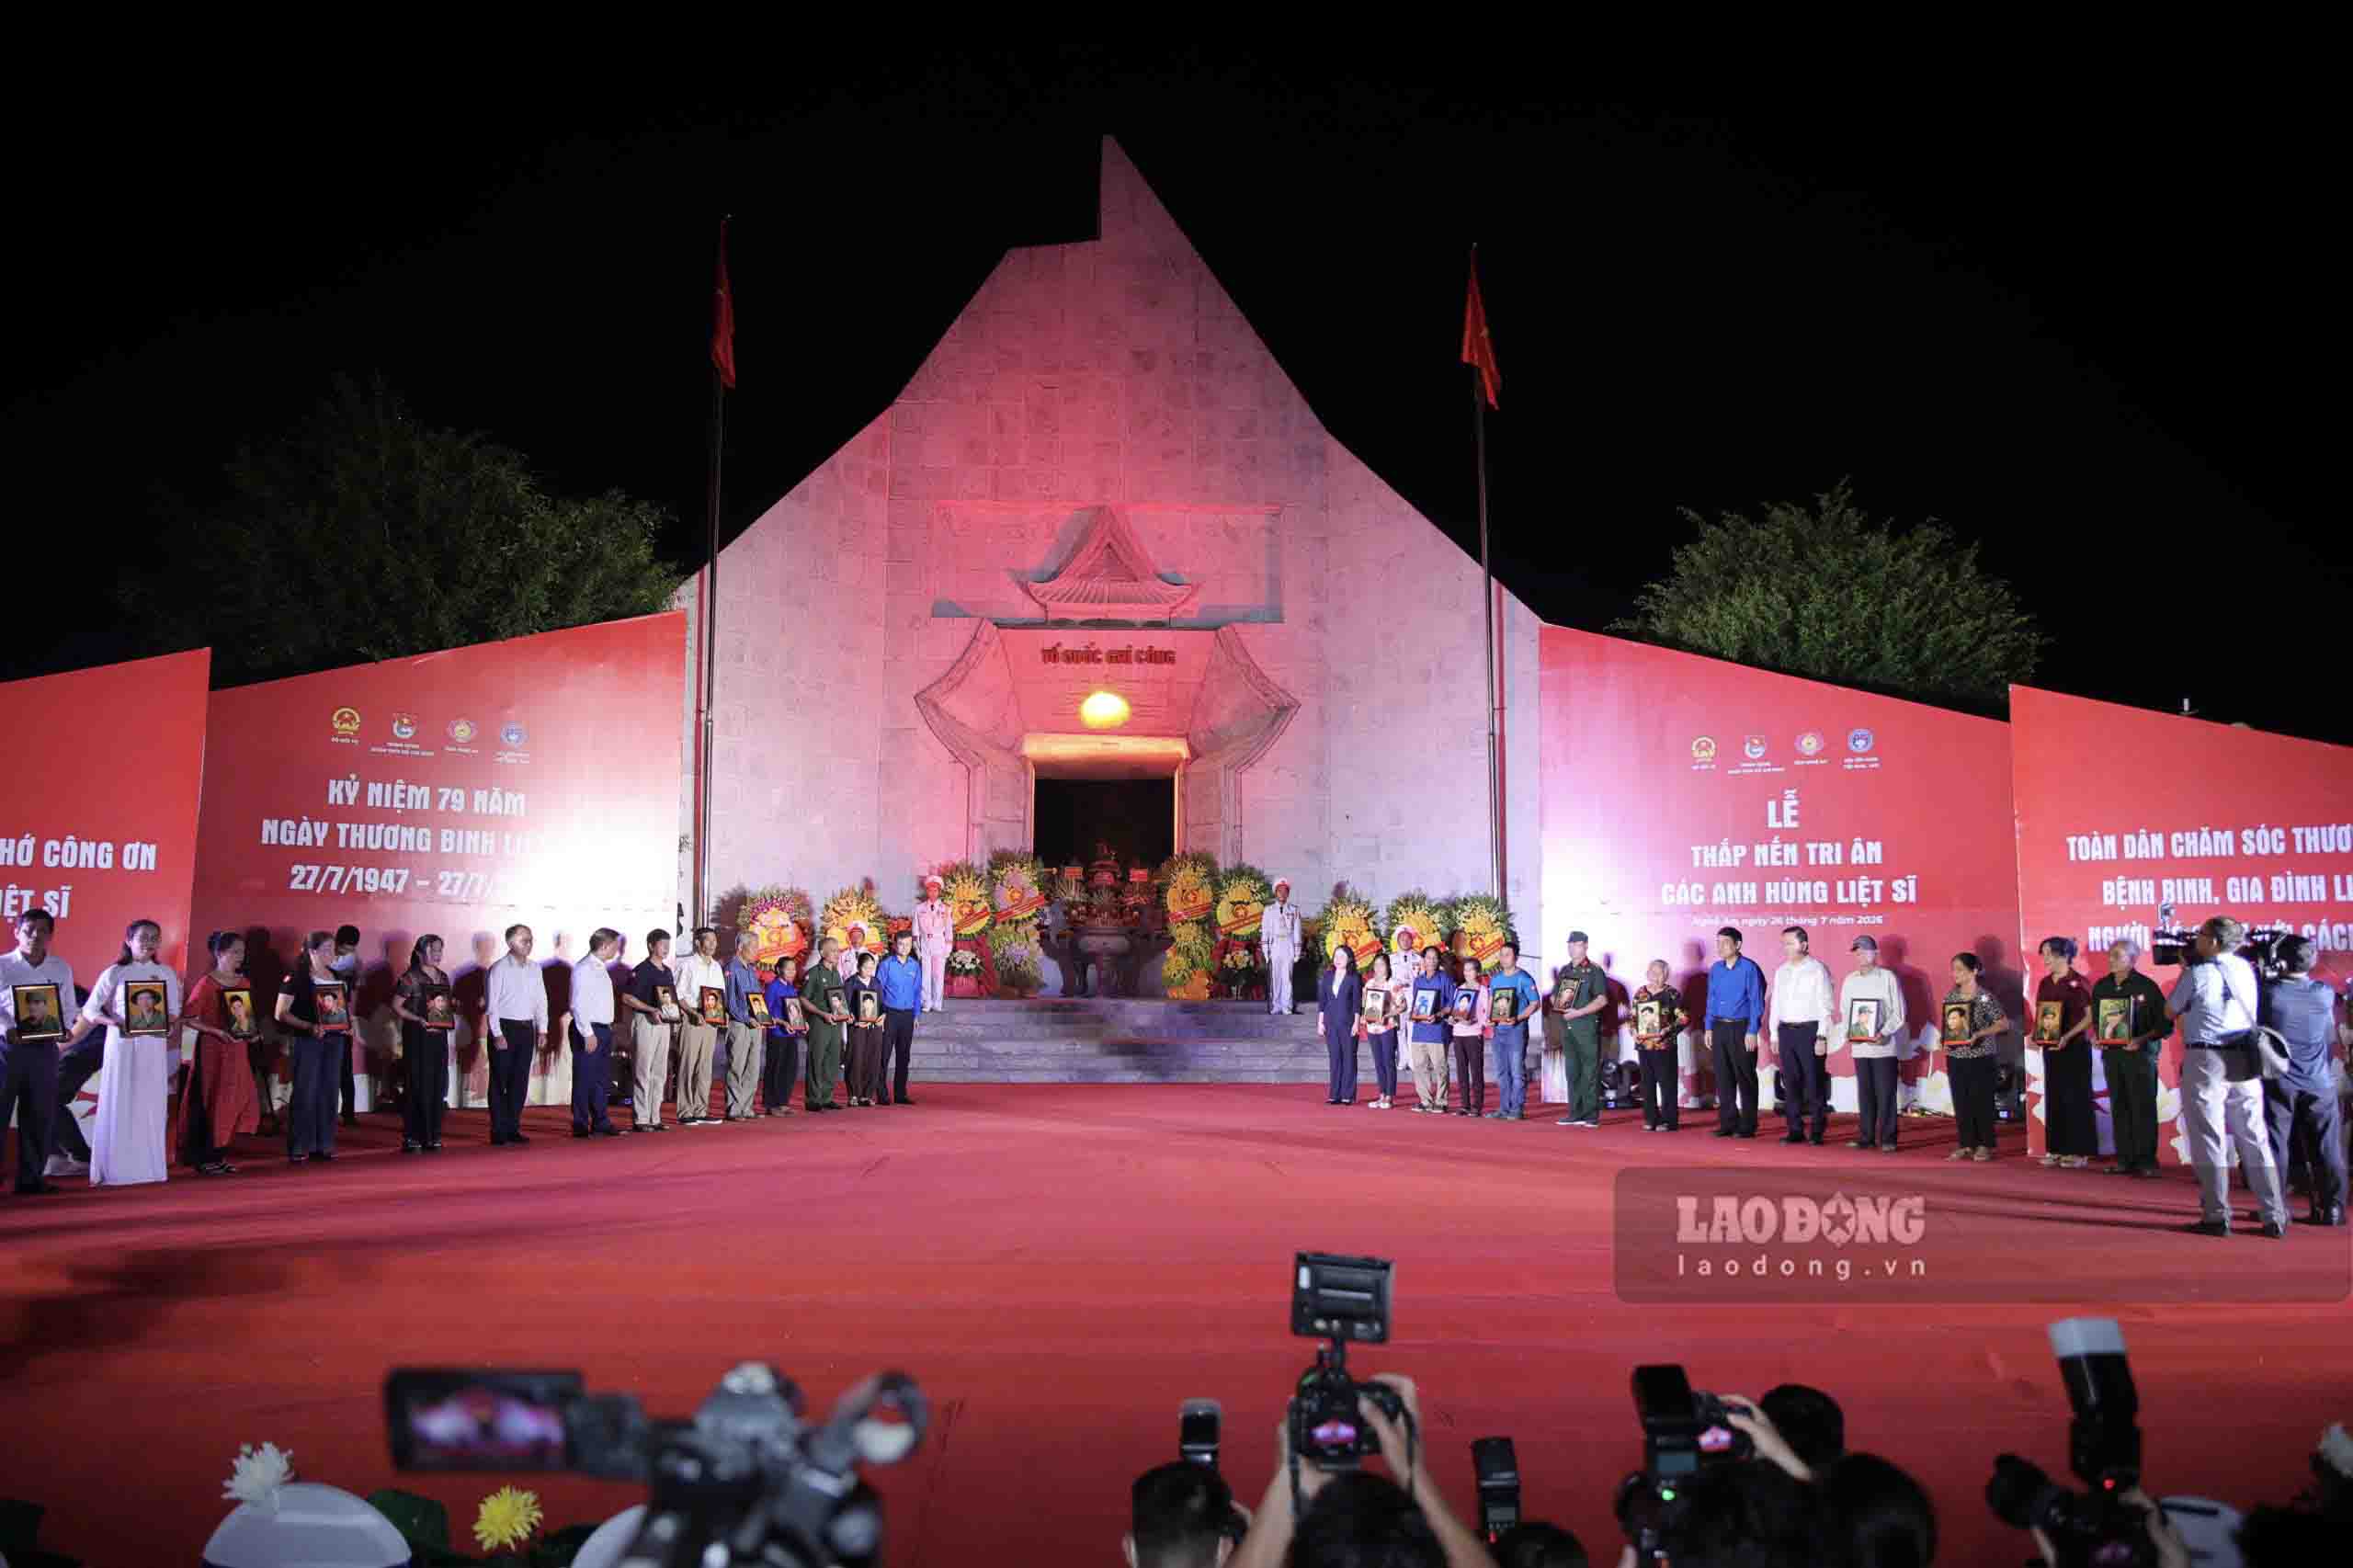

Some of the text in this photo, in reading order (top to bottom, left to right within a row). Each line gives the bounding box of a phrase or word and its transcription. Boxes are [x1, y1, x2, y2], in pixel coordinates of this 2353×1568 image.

[327, 773, 527, 816] KỶ NIỆM 79 NĂM
[1767, 788, 1801, 828] LỄ
[43, 835, 114, 869] CÔNG
[122, 841, 158, 870] ƠN
[261, 816, 329, 847] NGÀY
[336, 822, 432, 853] THƯƠNG
[440, 829, 494, 854] BINH
[1691, 835, 1883, 868] THẮP NẾN TRI ÂN
[2066, 832, 2117, 861] TOÀN
[2123, 829, 2164, 859] DÂN
[2171, 826, 2234, 858] CHĂM
[2242, 824, 2286, 856] SÓC
[288, 865, 410, 895] 27/7/1947
[1661, 874, 1917, 908] CÁC ANH HÙNG LIỆT SĨ
[2102, 876, 2154, 910] BỆNH
[2227, 877, 2265, 903] GIA
[2271, 869, 2327, 903] ĐÌNH
[42, 884, 73, 918] SĨ
